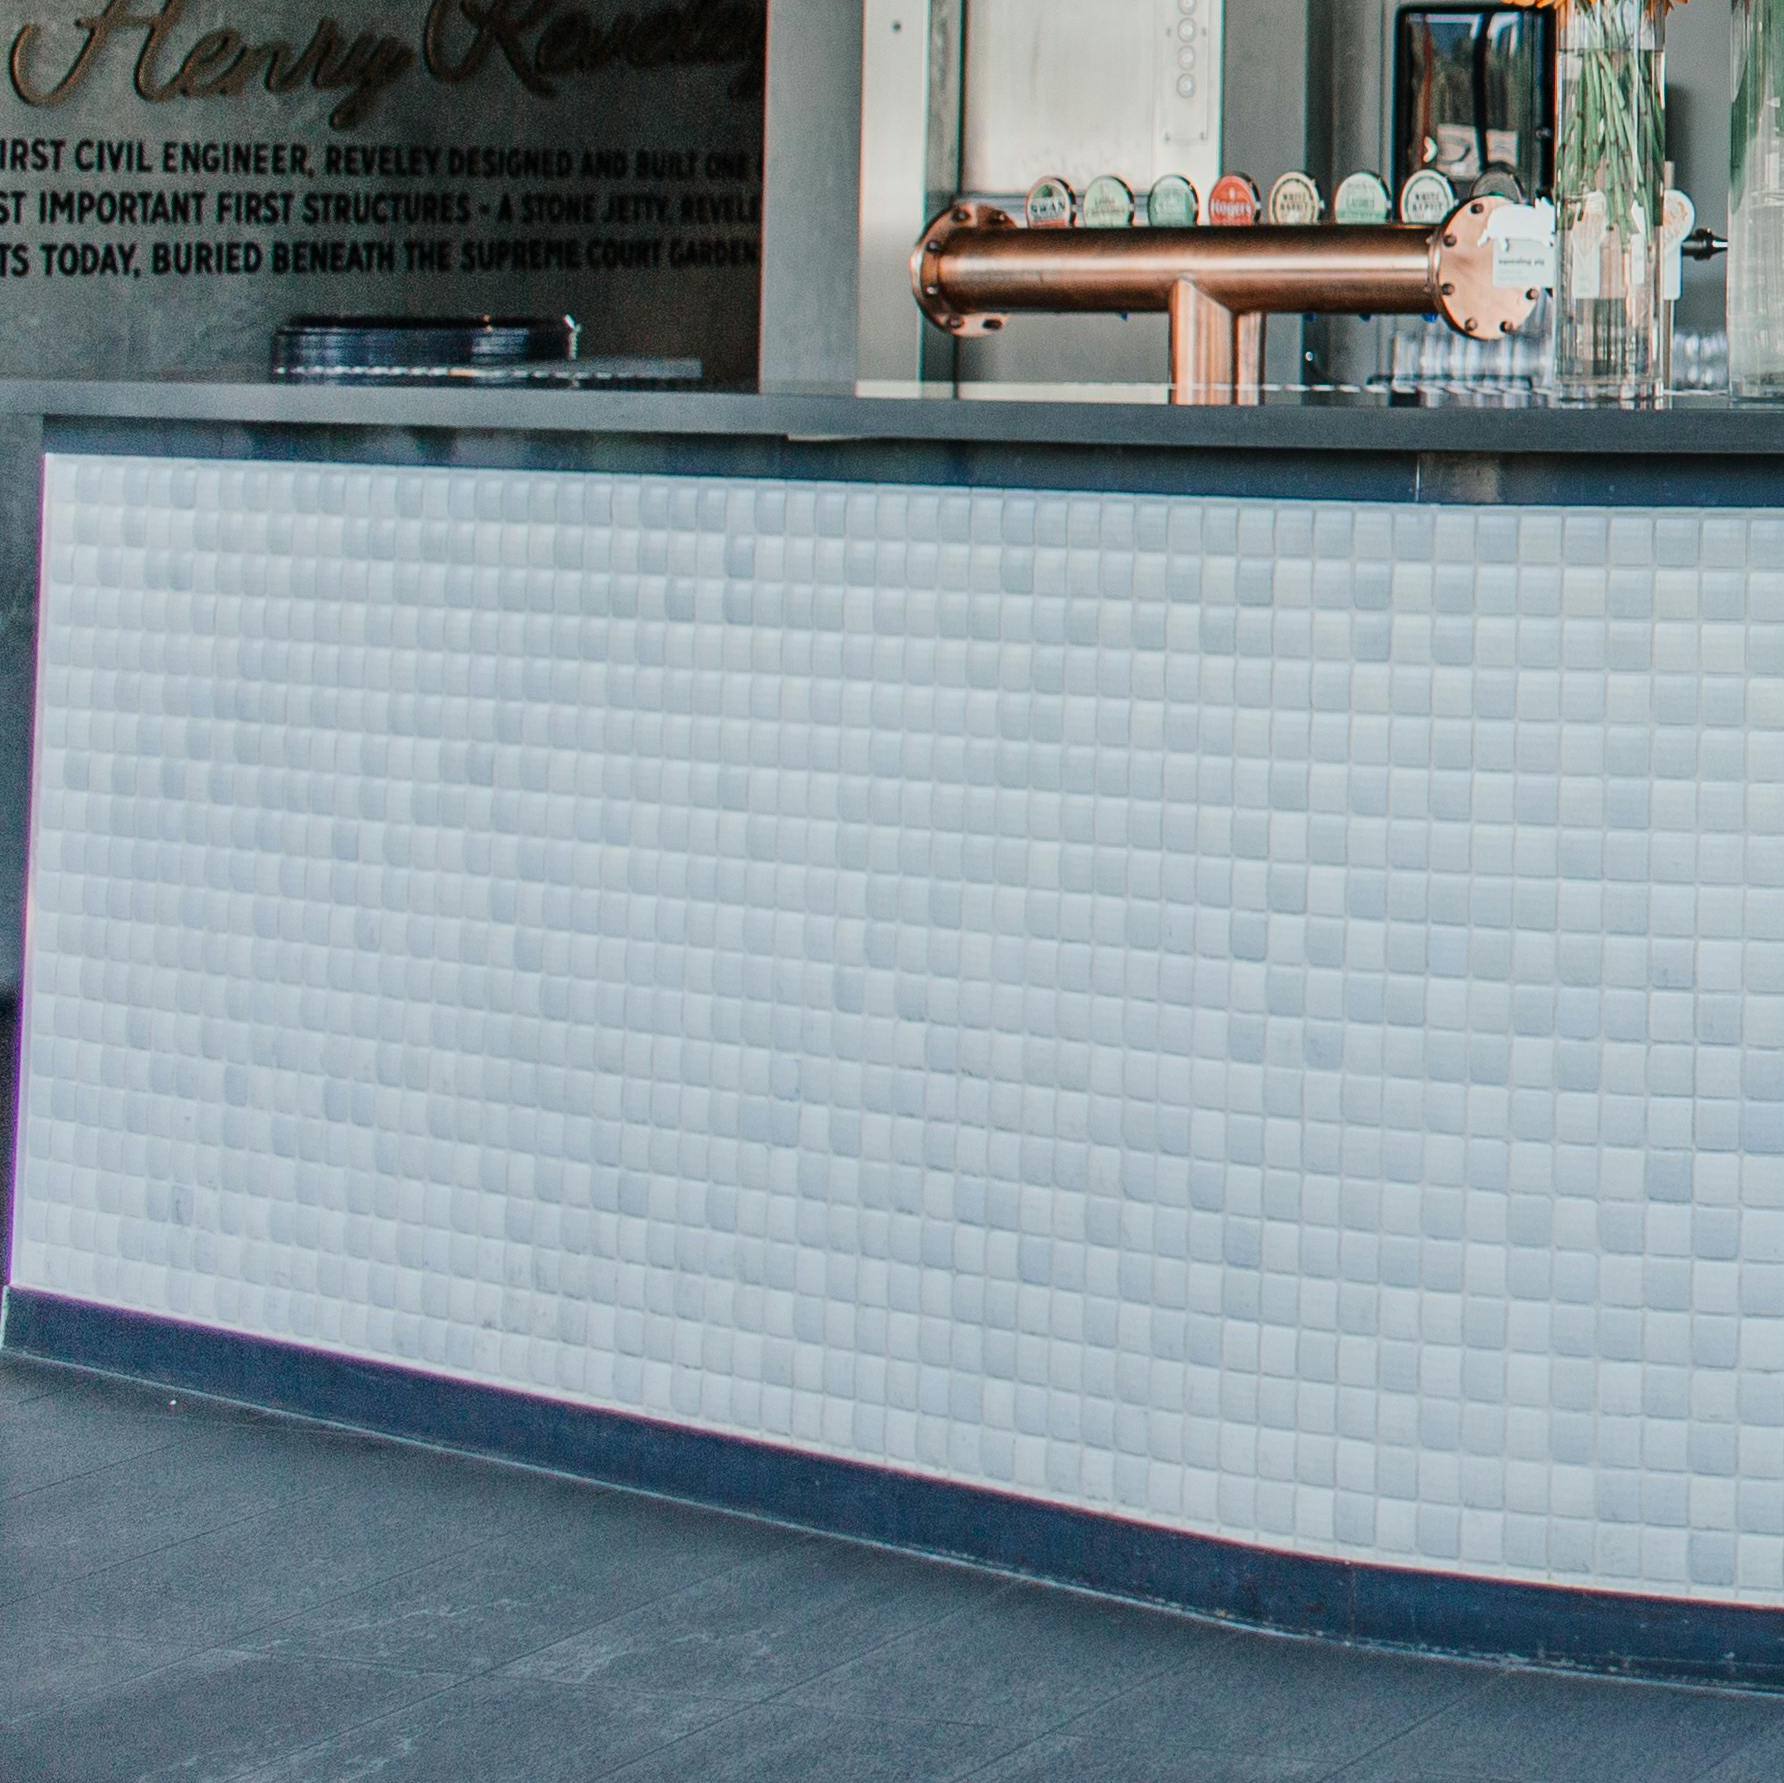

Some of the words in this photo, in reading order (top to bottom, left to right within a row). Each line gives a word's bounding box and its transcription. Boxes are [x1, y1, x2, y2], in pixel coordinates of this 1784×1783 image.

[0, 137, 66, 173] IRST
[73, 138, 153, 174] CIVIL
[161, 140, 316, 179] ENGINEER,
[324, 143, 441, 178] REVELEY
[447, 145, 572, 180] DESIGNED
[581, 148, 628, 180] AND
[634, 148, 698, 181] BUILT
[704, 150, 748, 181] ONE
[39, 189, 207, 226] IMPORTANT
[215, 190, 296, 226] FIRST
[302, 190, 470, 226] STRUCTURES
[496, 193, 512, 224] A
[521, 192, 597, 224] STONE
[40, 241, 141, 279] TODAY,
[151, 240, 263, 276] BURIED
[270, 240, 395, 275] BENEATH
[404, 239, 451, 273] THE
[460, 239, 581, 274] SUPREME
[587, 238, 661, 270] COURT
